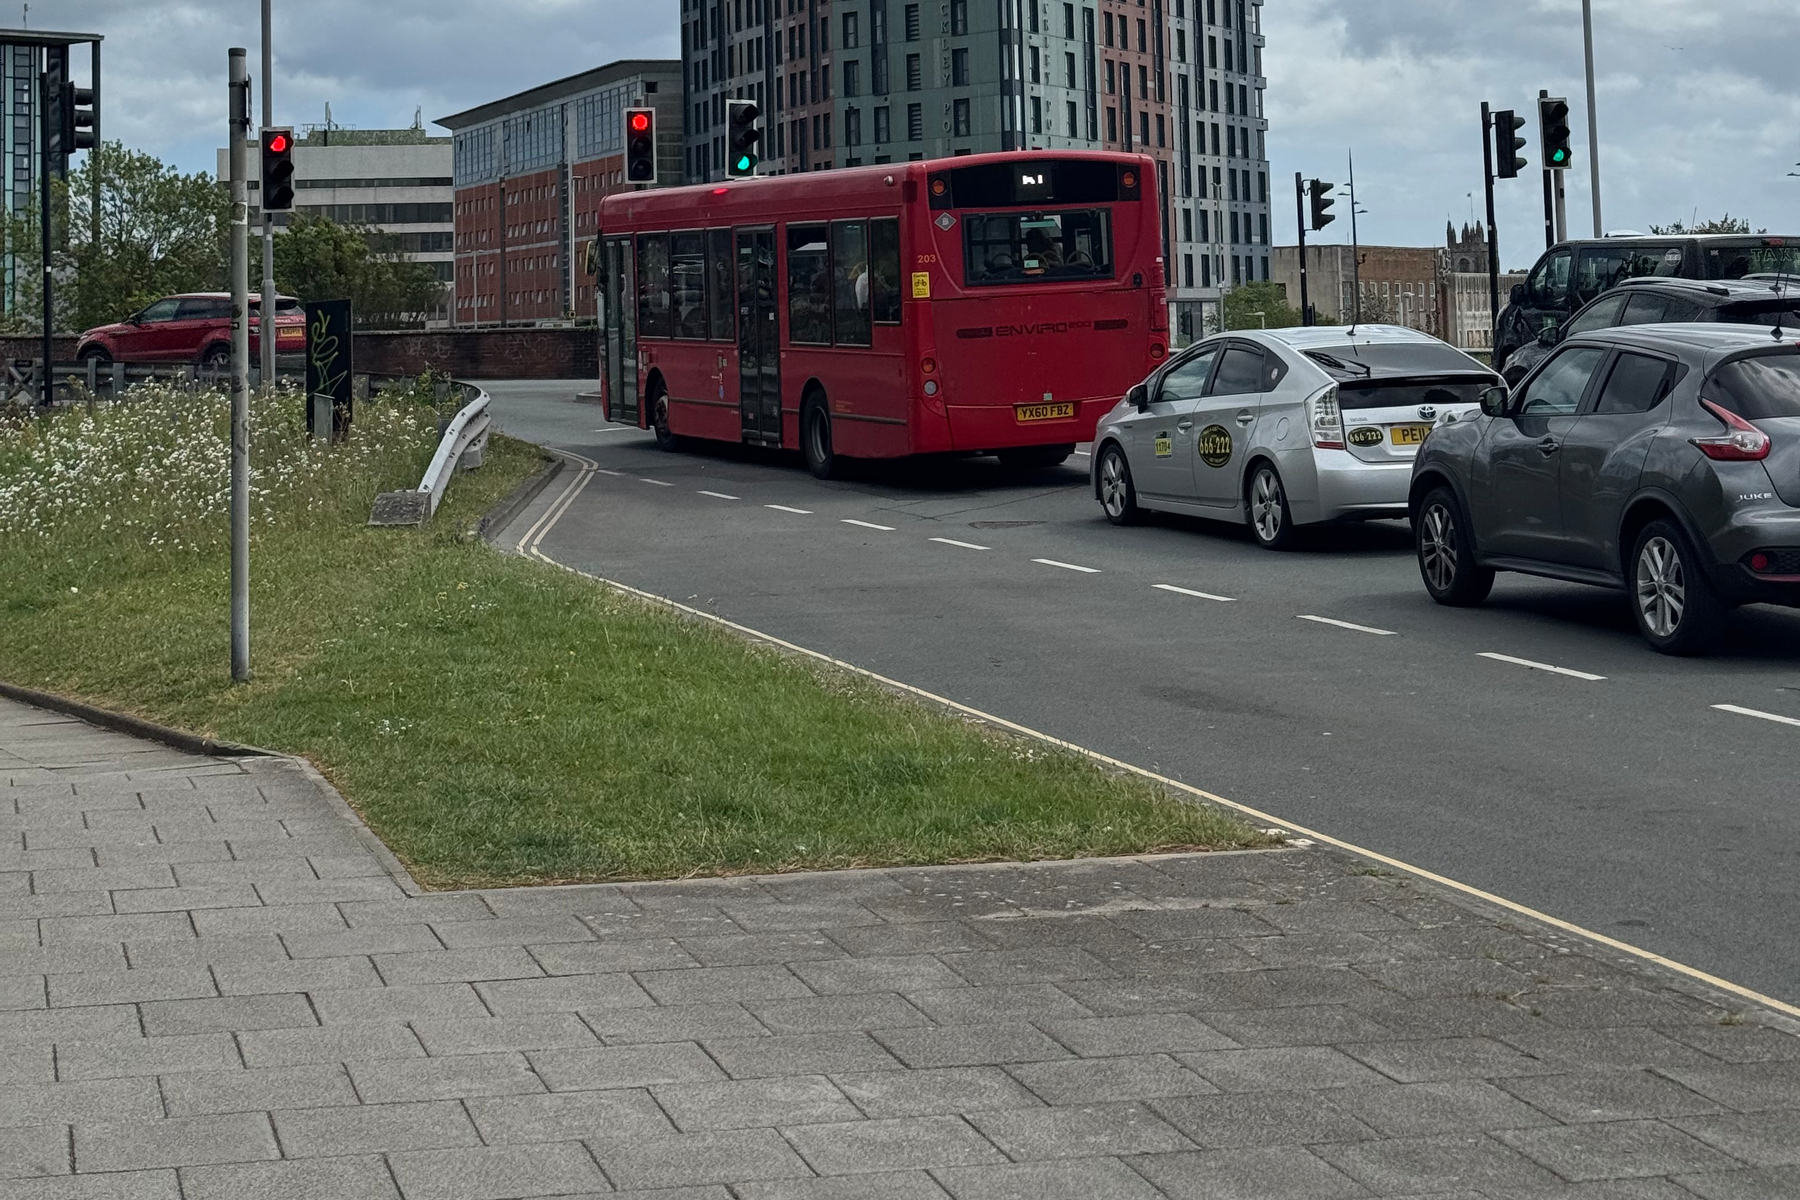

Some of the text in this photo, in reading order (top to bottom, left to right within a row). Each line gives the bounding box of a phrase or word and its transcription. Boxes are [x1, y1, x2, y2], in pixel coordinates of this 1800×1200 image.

[917, 254, 937, 264] 203
[1750, 247, 1799, 262] TAXI
[1021, 404, 1070, 419] YX60 FBZ
[1199, 436, 1230, 455] 666-222
[1735, 492, 1773, 503] JUKE
